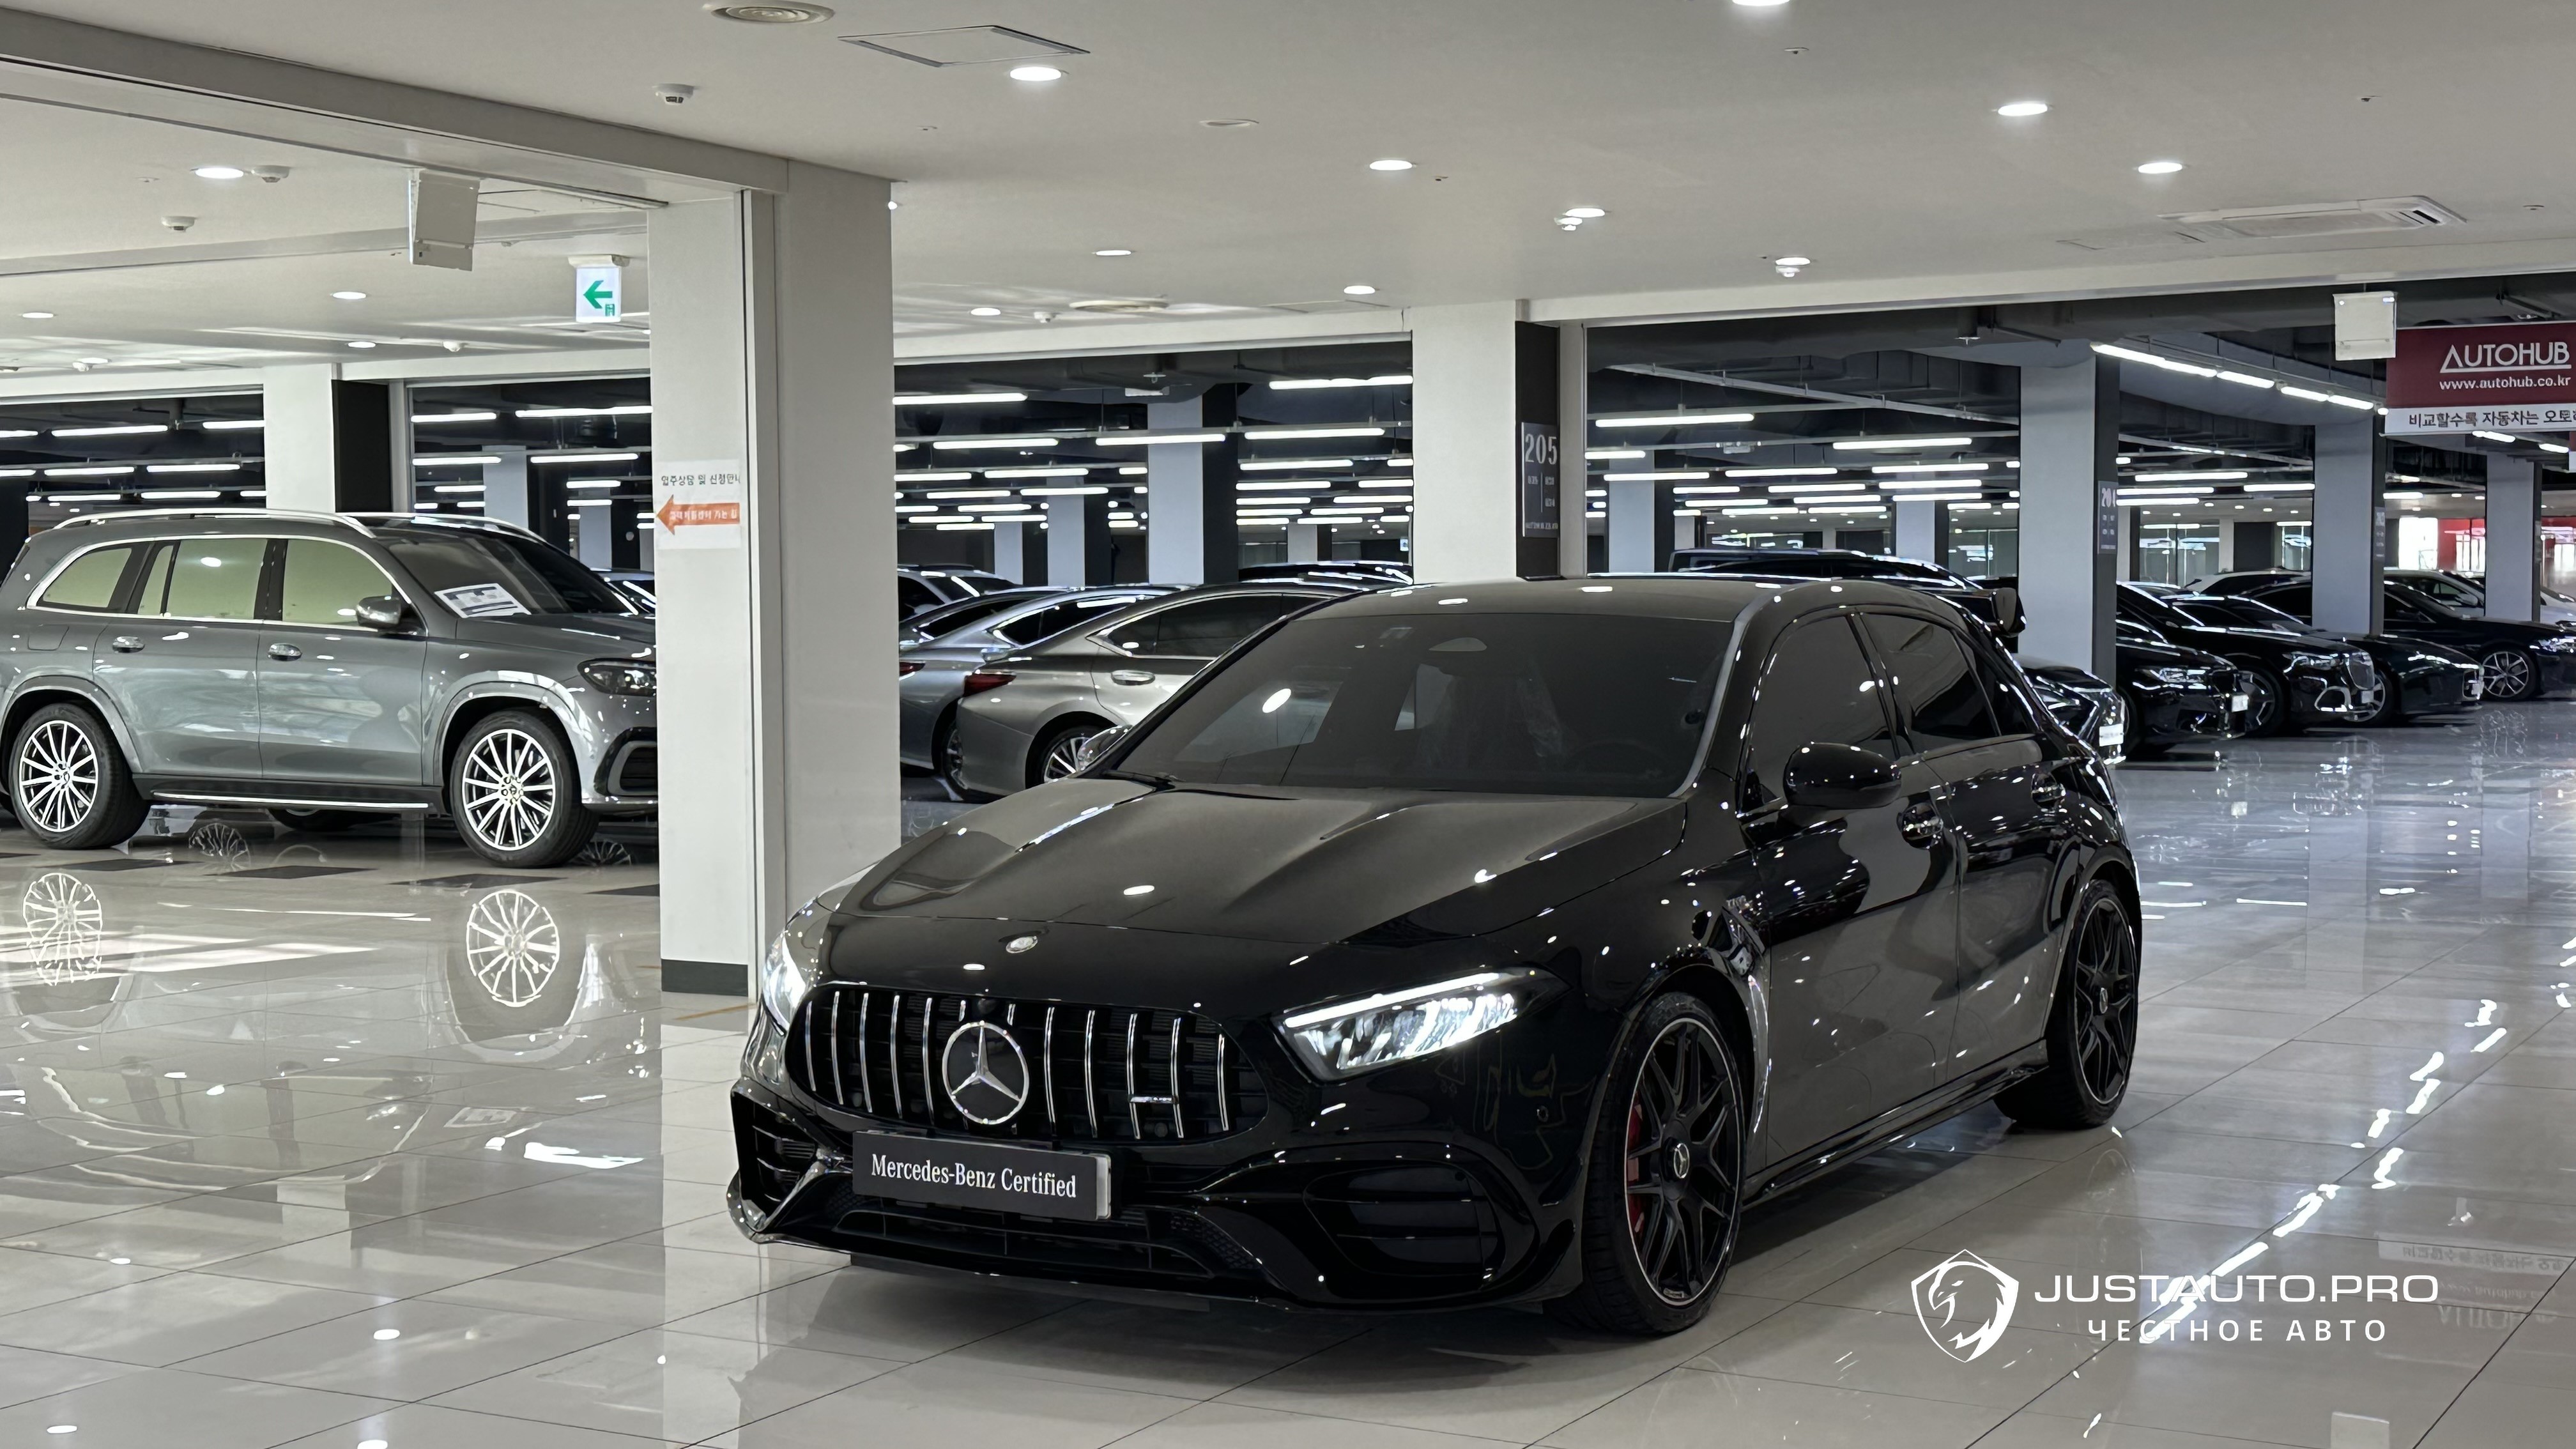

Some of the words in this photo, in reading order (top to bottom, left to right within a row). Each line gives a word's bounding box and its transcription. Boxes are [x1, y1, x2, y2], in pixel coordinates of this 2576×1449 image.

[2439, 341, 2572, 373] AUTOHUB
[2439, 374, 2571, 390] www.autohub.co.kr
[2483, 410, 2540, 426] 자동차는
[1525, 434, 1558, 465] 205
[871, 1154, 995, 1189] Mercedes-Benz
[1001, 1168, 1077, 1198] Certified
